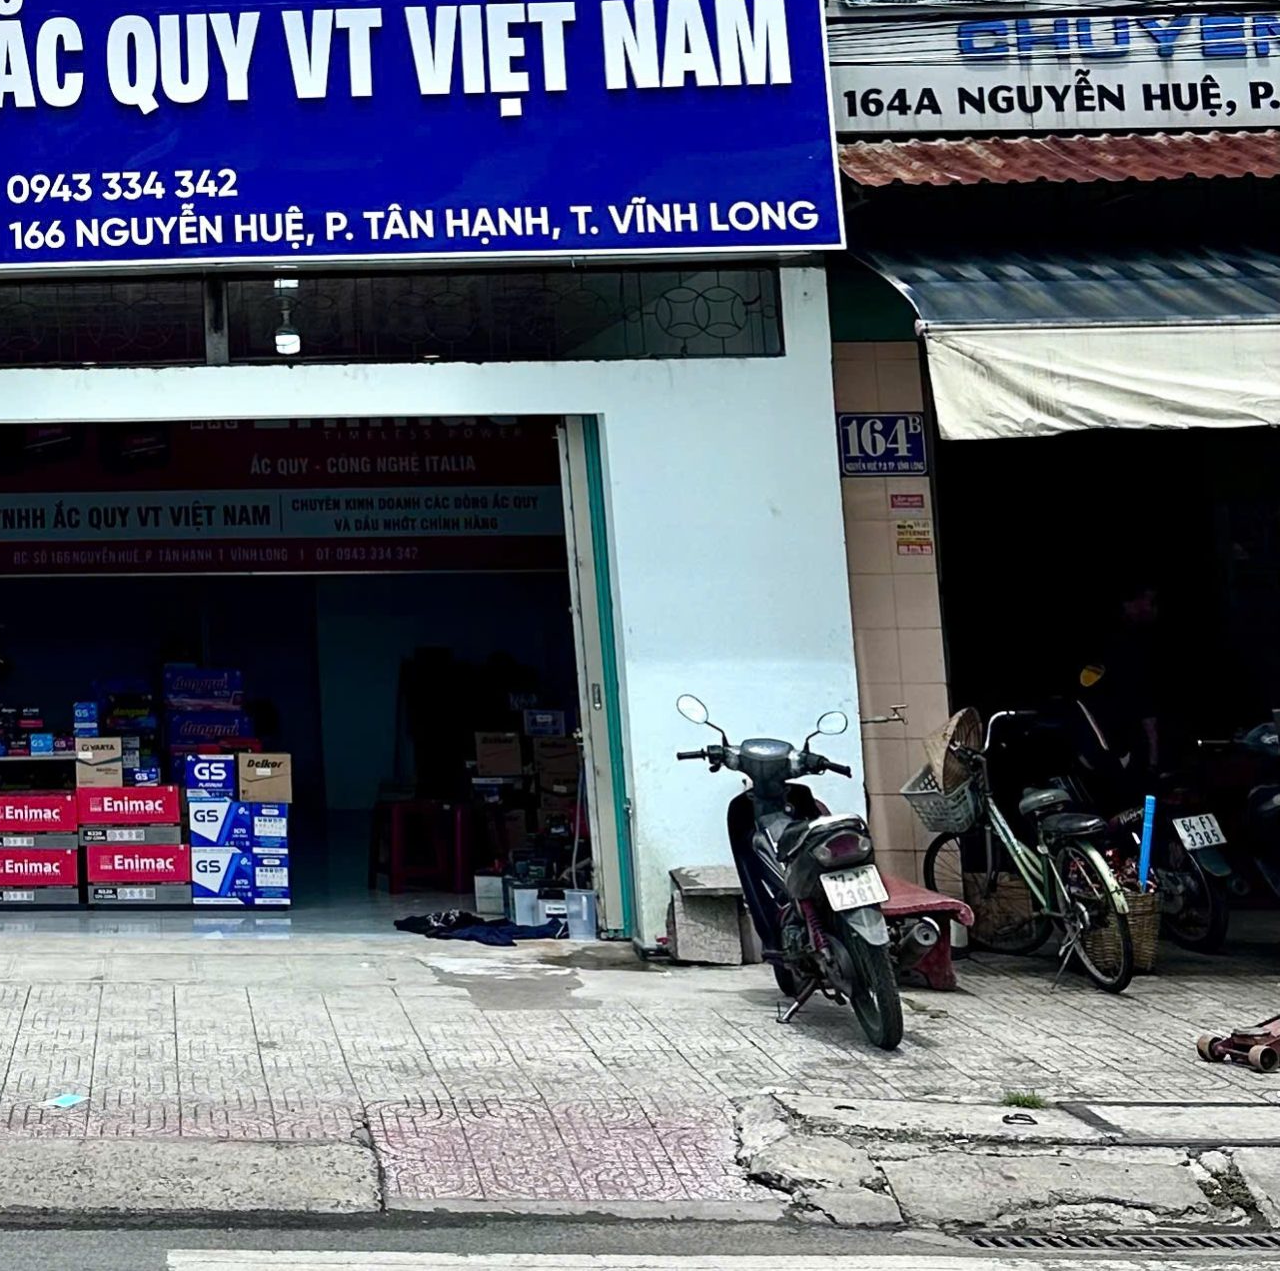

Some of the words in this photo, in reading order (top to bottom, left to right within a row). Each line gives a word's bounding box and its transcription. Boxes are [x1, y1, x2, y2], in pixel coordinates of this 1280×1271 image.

[107, 11, 260, 115] QUY
[281, 8, 382, 98] VT
[843, 88, 942, 118] 164A
[958, 68, 1126, 115] NGUYỄN
[1143, 75, 1237, 117] HUỆ,
[6, 174, 94, 204] 0943
[101, 170, 166, 201] 334
[173, 168, 238, 199] 342
[9, 220, 66, 251] 166
[75, 206, 222, 248] NGUYỄN
[234, 204, 316, 246] HUỆ,
[326, 211, 356, 241] P.
[362, 202, 435, 239] TÂN
[446, 205, 561, 244] HẠNH,
[568, 205, 599, 235] T.
[608, 193, 700, 234] VĨNH
[710, 199, 819, 231] LONG
[277, 456, 309, 477] QUY
[425, 454, 476, 473] ITALIA
[344, 496, 374, 511] KINH
[378, 496, 420, 510] DOANH
[53, 500, 80, 528] ẮC
[88, 506, 129, 529] QUY
[137, 506, 163, 527] VT
[169, 500, 216, 530] VIỆT
[223, 505, 271, 526] NAM
[194, 762, 227, 780] GS
[247, 759, 283, 768] Delkor
[5, 806, 60, 820] Enimac
[103, 796, 163, 813] Enimac
[194, 810, 218, 822] GS
[1187, 829, 1220, 847] 3385
[5, 860, 60, 873] Enimac
[114, 854, 174, 870] Enimac
[196, 860, 220, 873] GS
